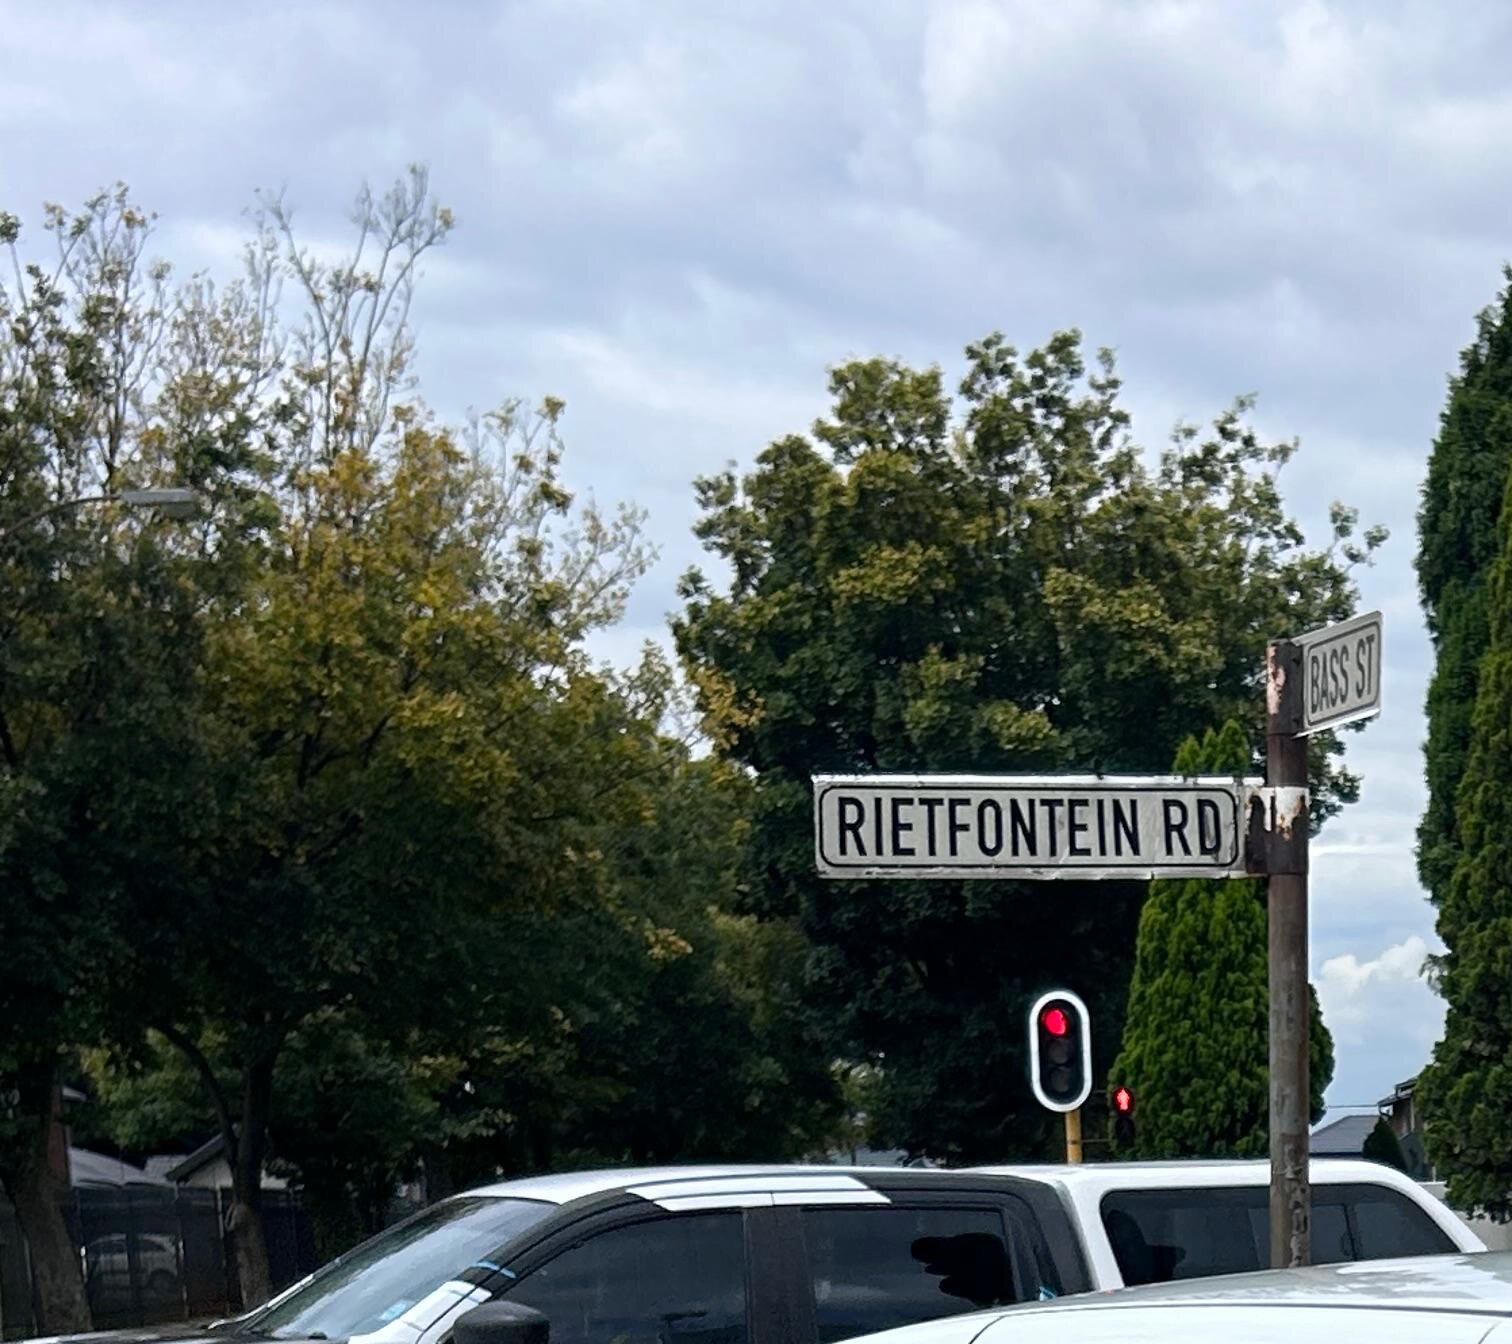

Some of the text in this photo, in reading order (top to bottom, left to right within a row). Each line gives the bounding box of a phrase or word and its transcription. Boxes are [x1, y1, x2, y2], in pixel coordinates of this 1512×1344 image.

[1310, 634, 1375, 714] BASS ST
[838, 796, 1221, 858] RIETFONTEIN RD
